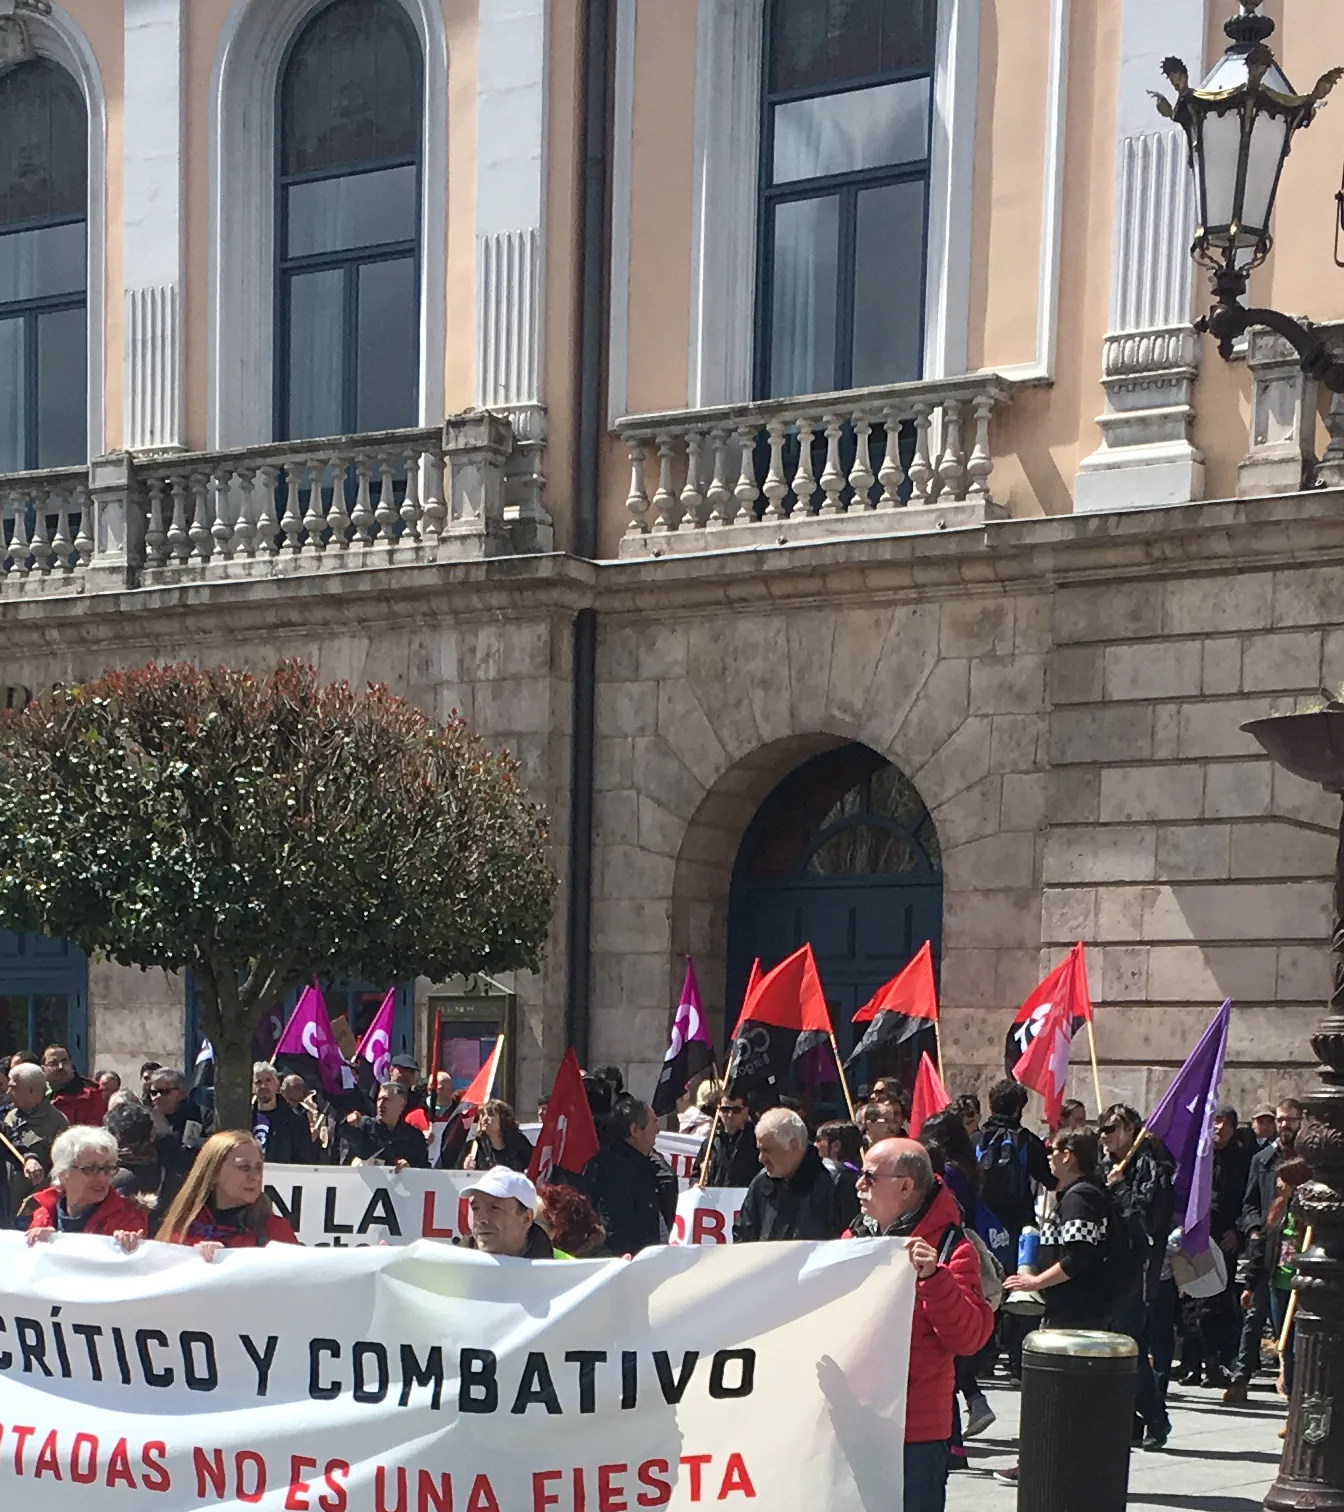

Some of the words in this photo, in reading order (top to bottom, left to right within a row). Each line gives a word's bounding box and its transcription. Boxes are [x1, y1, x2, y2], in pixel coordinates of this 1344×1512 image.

[324, 1186, 404, 1237] LA
[238, 1333, 279, 1397] Y
[308, 1337, 757, 1416] COMBATIVO
[192, 1445, 268, 1504] NO
